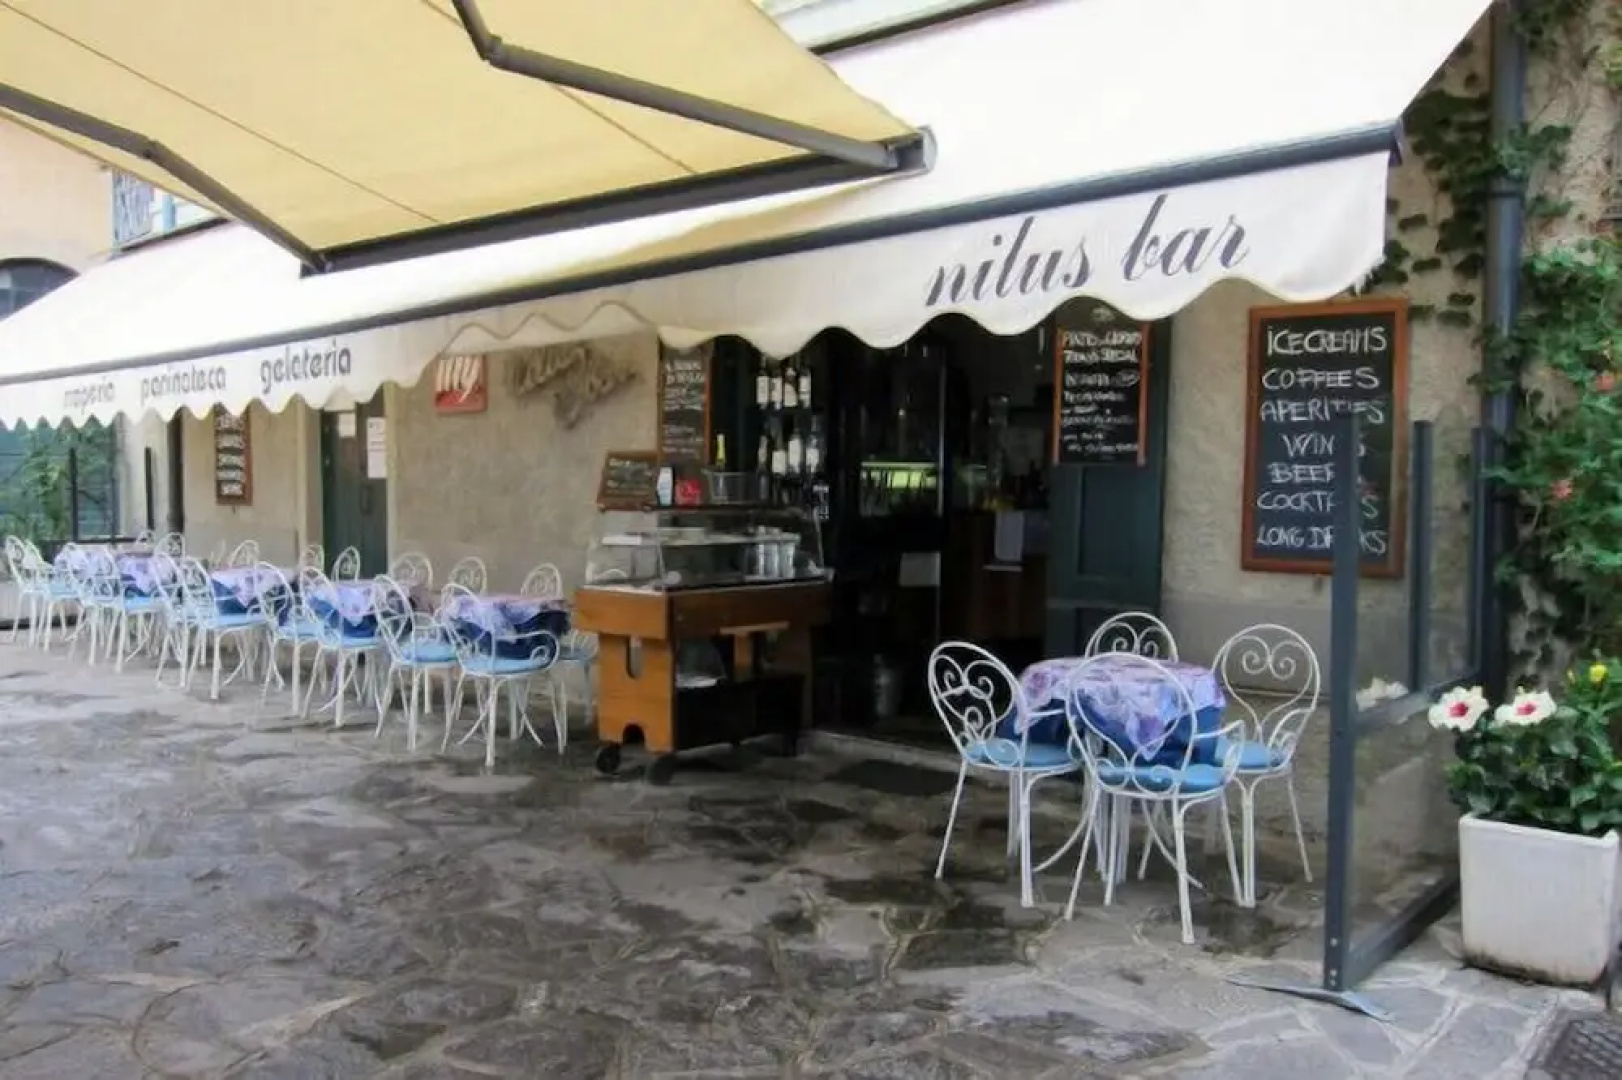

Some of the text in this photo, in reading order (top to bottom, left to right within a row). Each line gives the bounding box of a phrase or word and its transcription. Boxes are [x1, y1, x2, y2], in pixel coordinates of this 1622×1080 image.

[924, 194, 1250, 307] nilus bar
[140, 366, 227, 405] paninoteca
[260, 338, 351, 394] gelateria
[1261, 366, 1380, 389] COFFEES
[1279, 432, 1366, 457] WINS
[1256, 490, 1379, 519] COCKTAS
[1256, 525, 1387, 555] LONG DRKS
